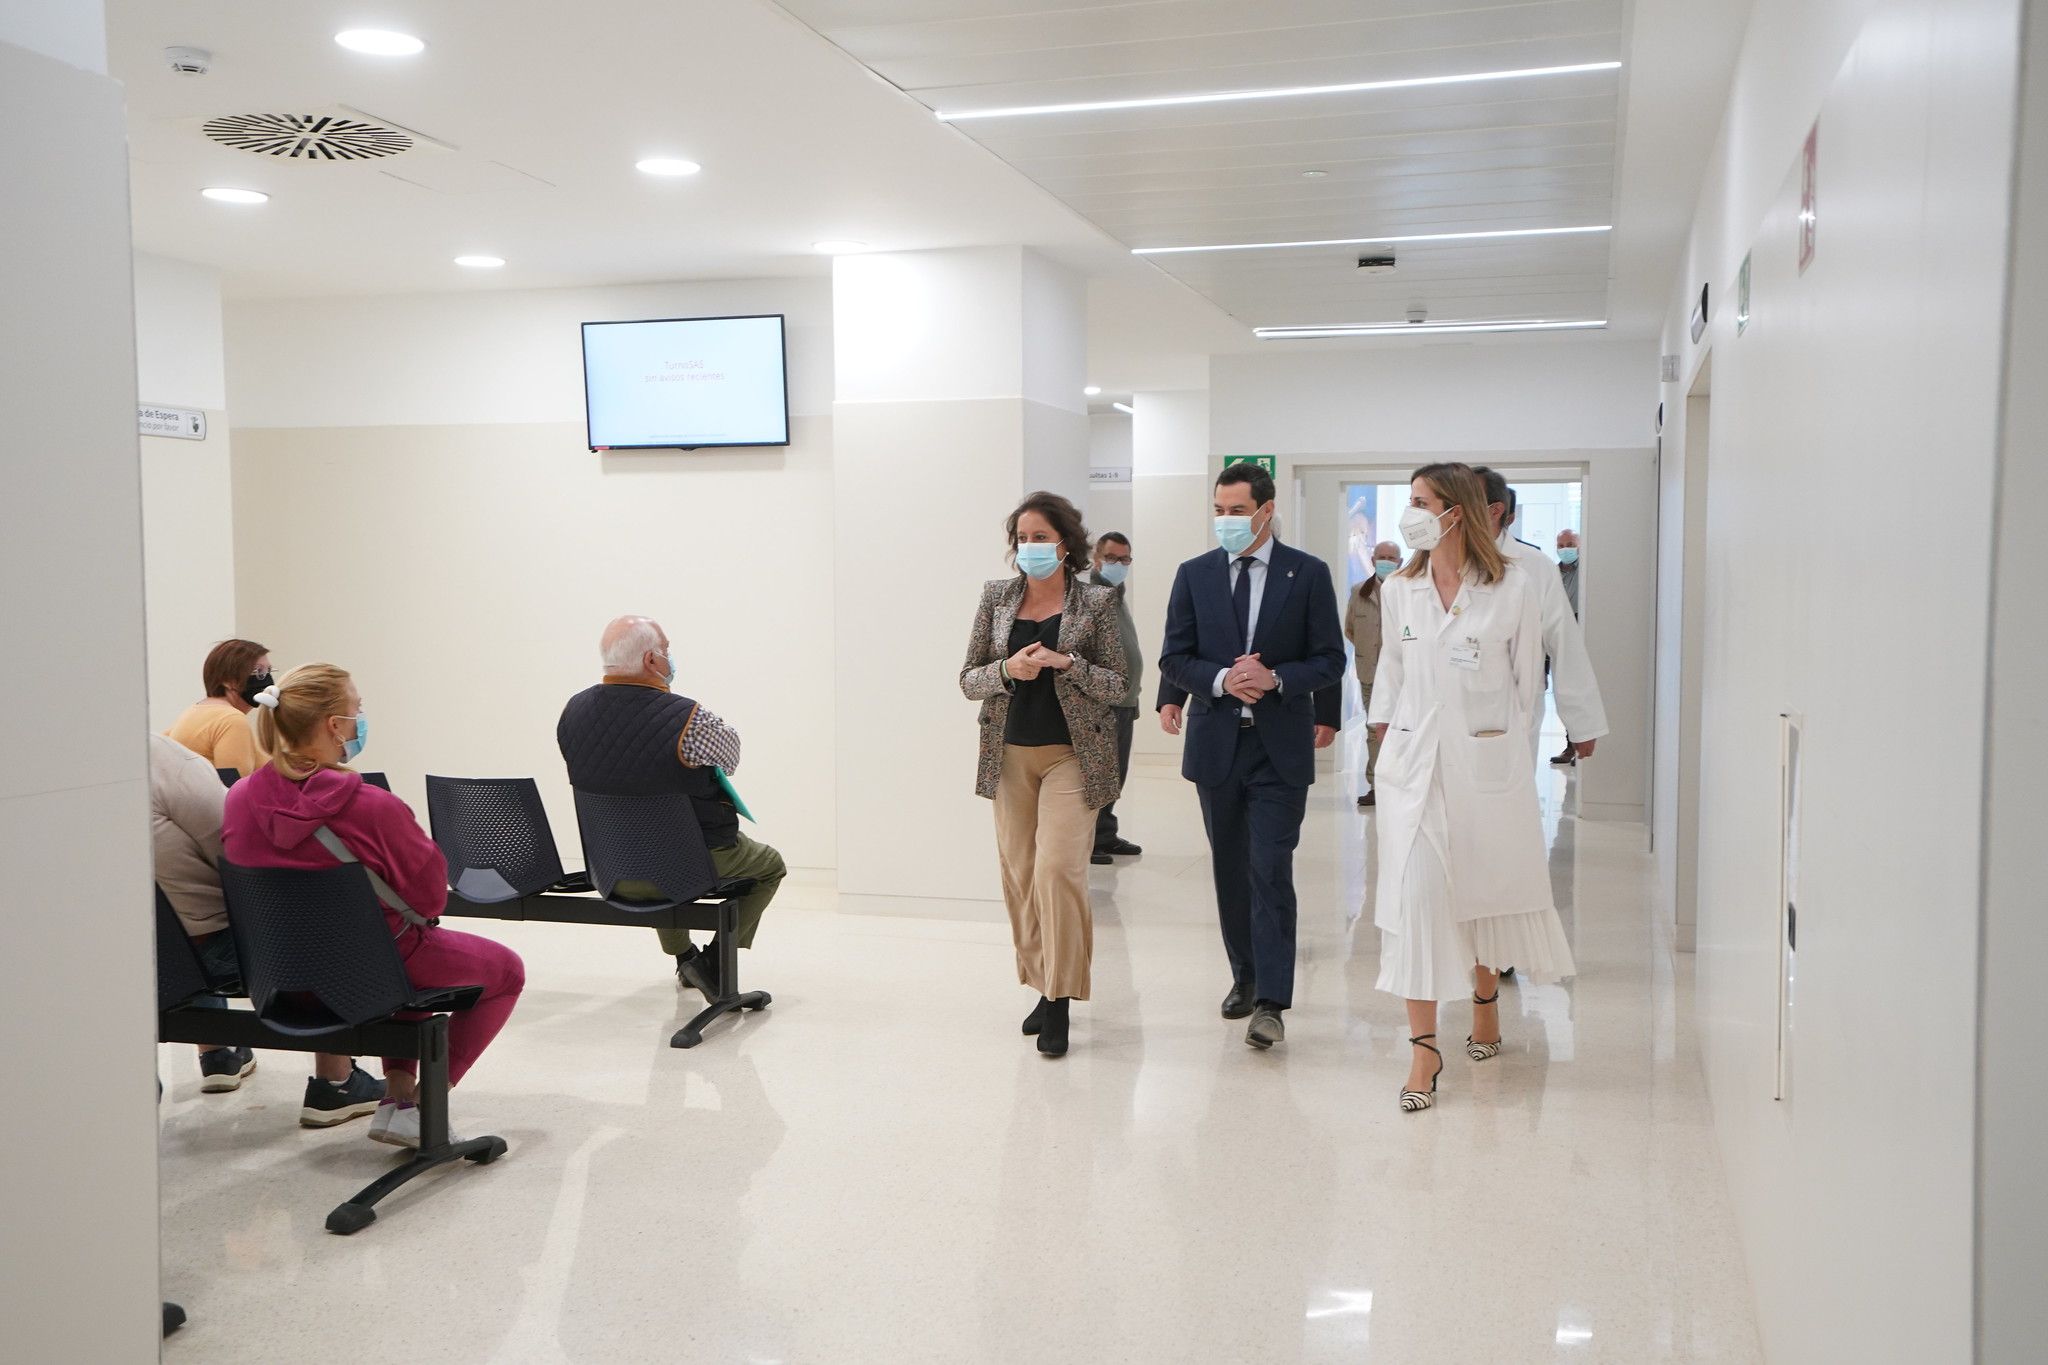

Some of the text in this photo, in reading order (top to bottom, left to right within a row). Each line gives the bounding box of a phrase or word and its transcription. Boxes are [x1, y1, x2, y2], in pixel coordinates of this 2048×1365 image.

[145, 409, 154, 418] de
[155, 410, 179, 421] Espera
[153, 423, 161, 432] por
[164, 422, 179, 431] favor
